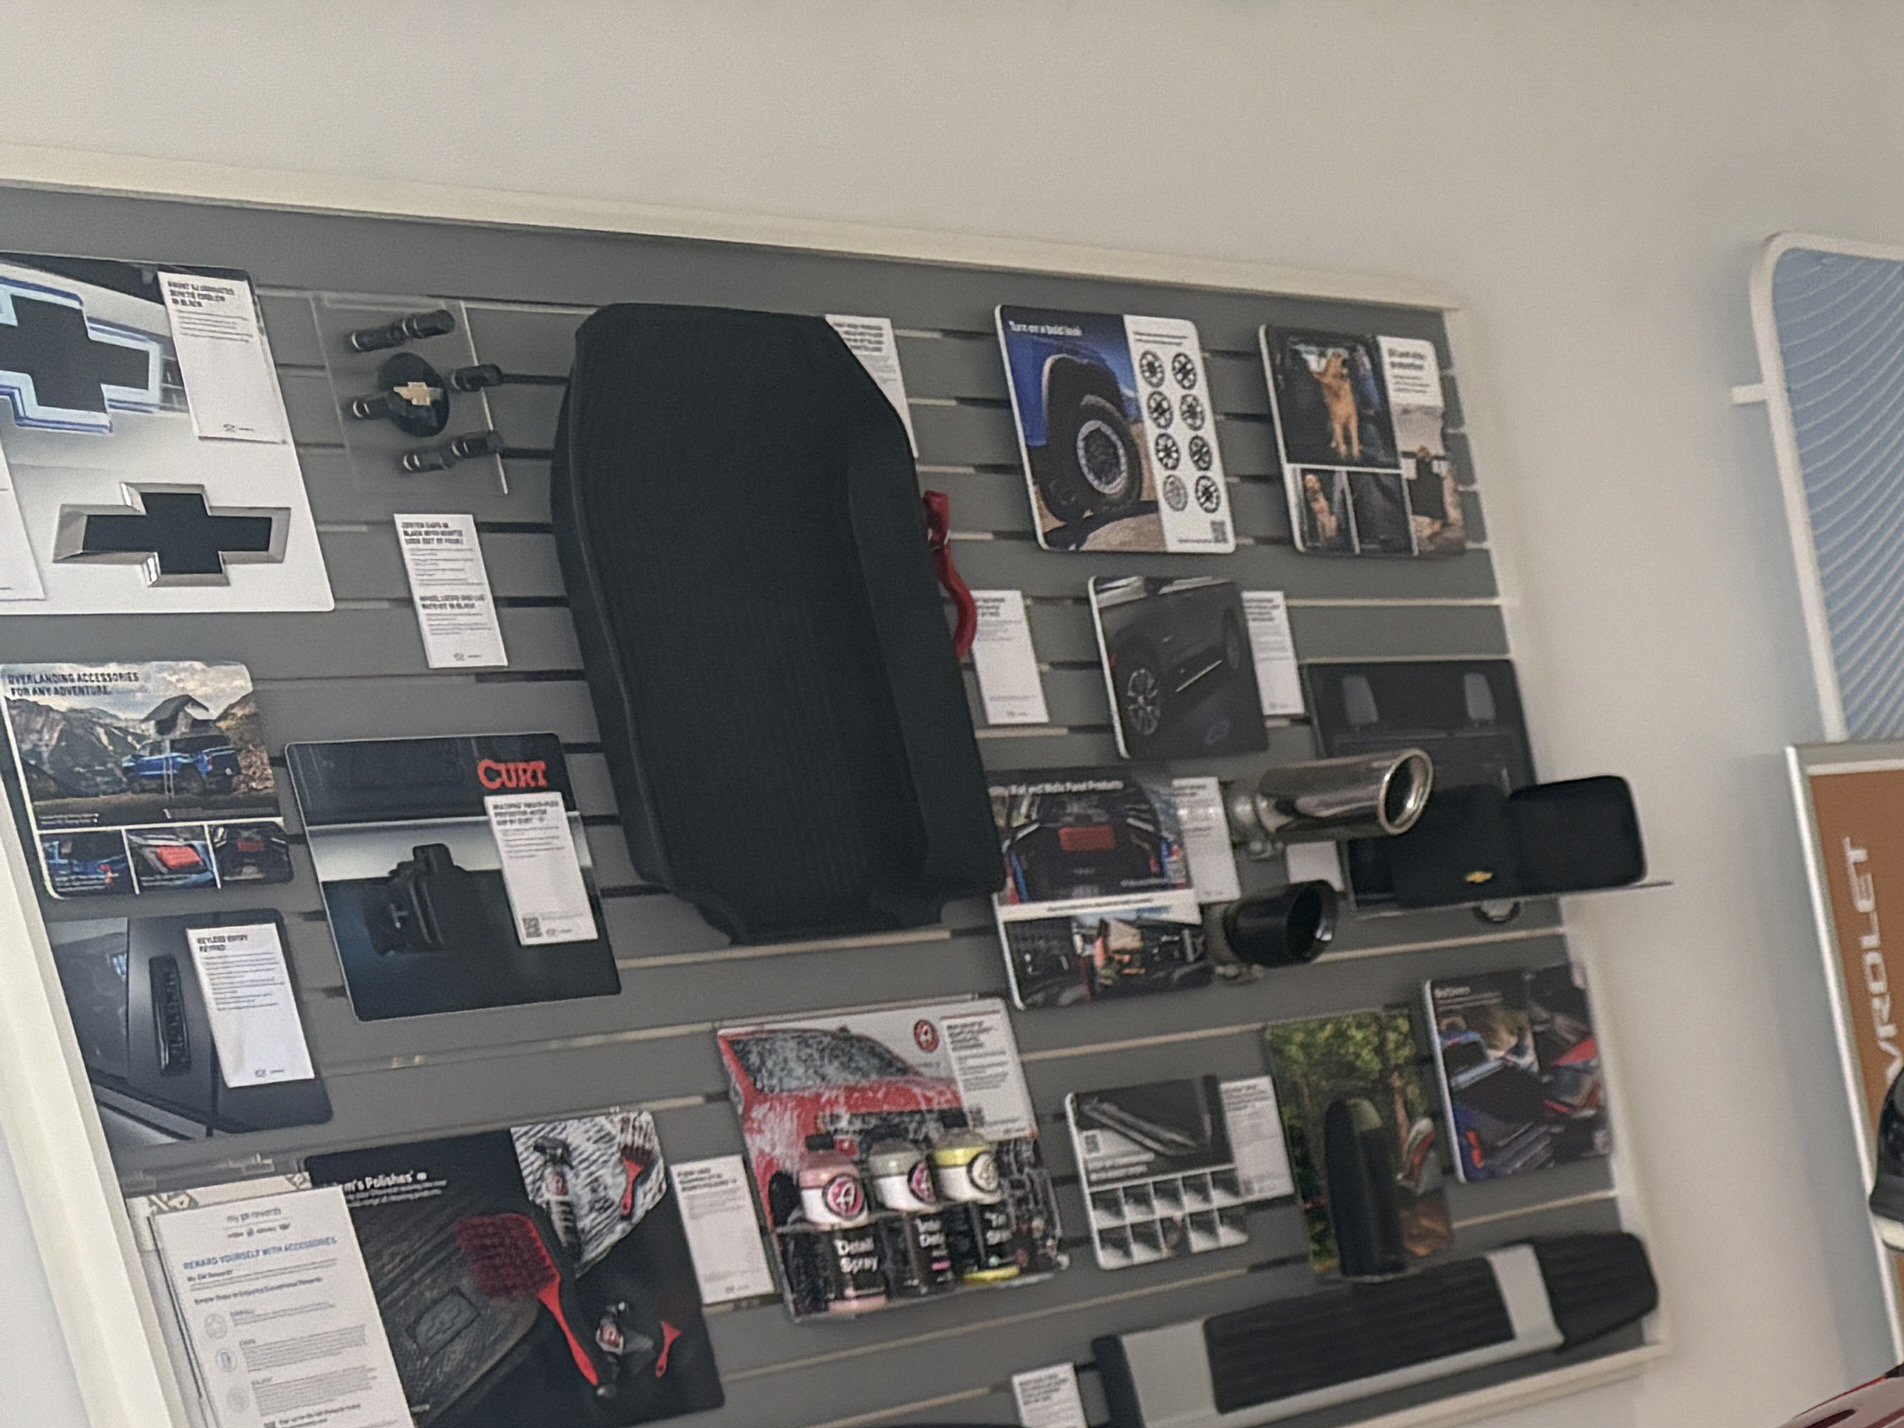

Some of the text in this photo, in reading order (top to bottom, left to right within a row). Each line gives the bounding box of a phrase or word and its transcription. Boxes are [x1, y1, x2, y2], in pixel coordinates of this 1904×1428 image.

[7, 671, 141, 685] OVERLANDING ACCESSORIES
[10, 687, 31, 697] FOR
[32, 686, 51, 697] ANY
[477, 759, 549, 790] CURT
[1843, 836, 1904, 1084] VROLET
